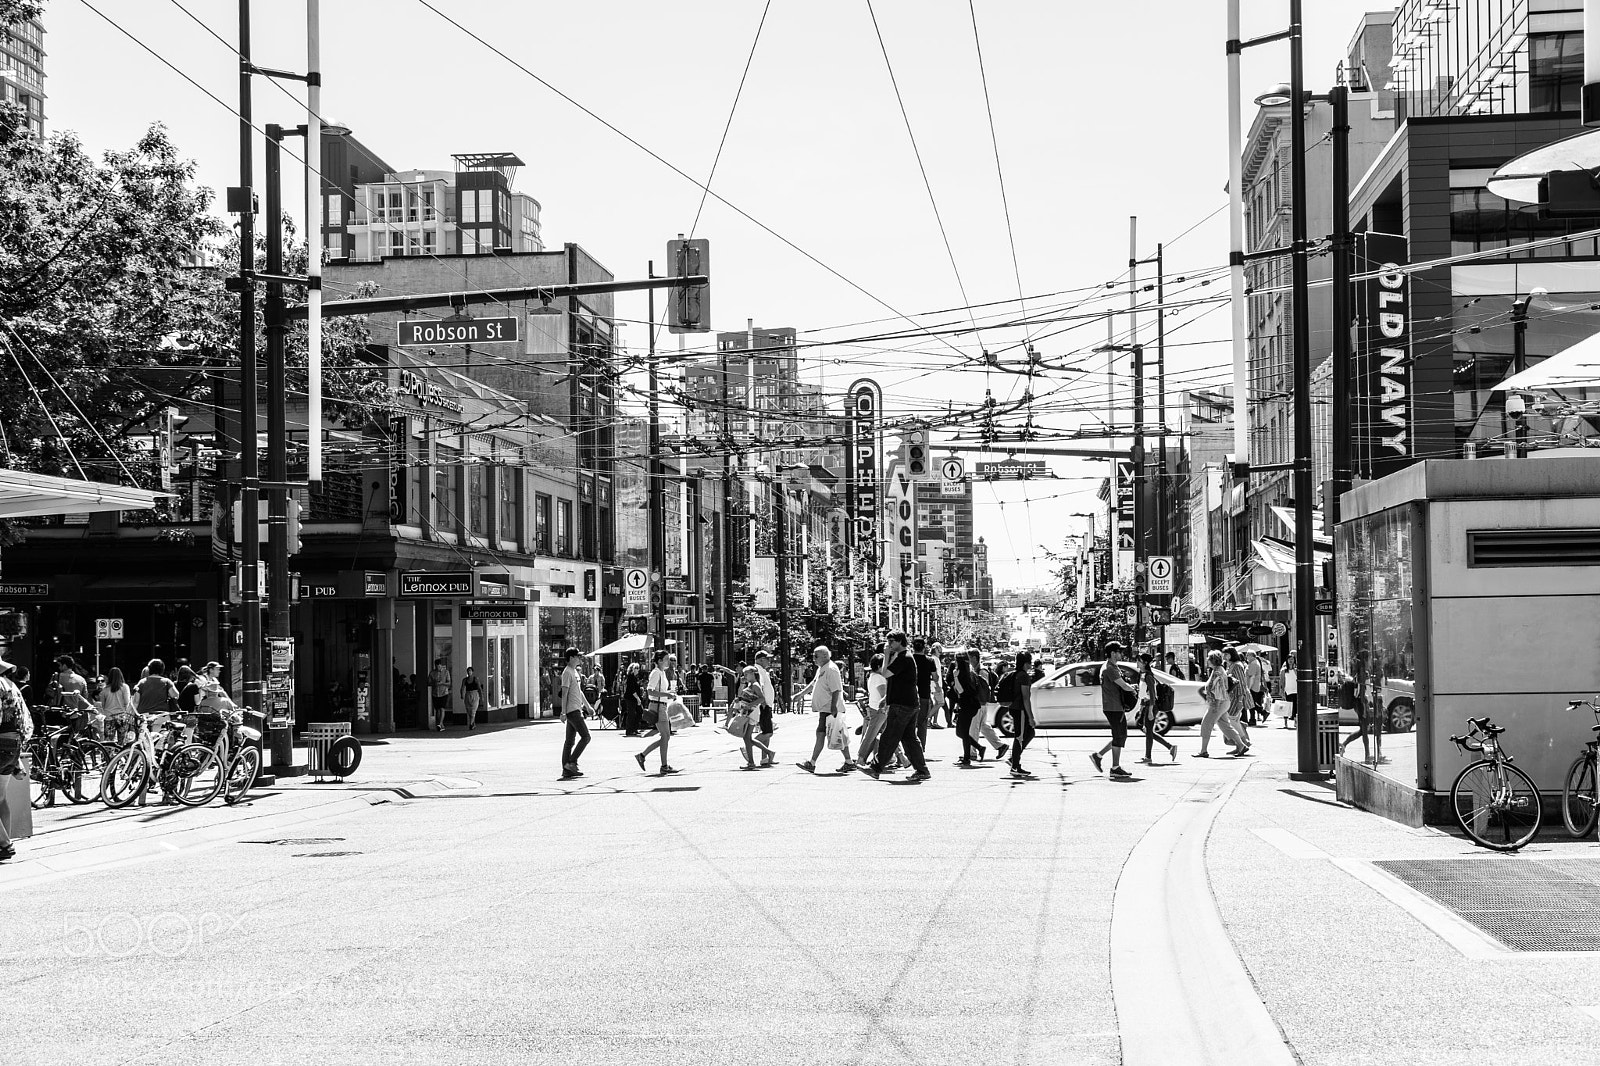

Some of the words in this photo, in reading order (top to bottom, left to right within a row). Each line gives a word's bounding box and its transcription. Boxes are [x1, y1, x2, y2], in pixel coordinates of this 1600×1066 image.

[1379, 262, 1404, 338] OLD
[413, 323, 478, 341] Robson
[486, 322, 503, 339] St
[1380, 348, 1407, 456] NAVY
[984, 463, 1022, 474] Robson
[1027, 463, 1037, 473] St
[0, 586, 27, 594] Robson
[315, 587, 336, 596] PUB
[404, 583, 447, 592] Lennox
[449, 583, 469, 591] PUB
